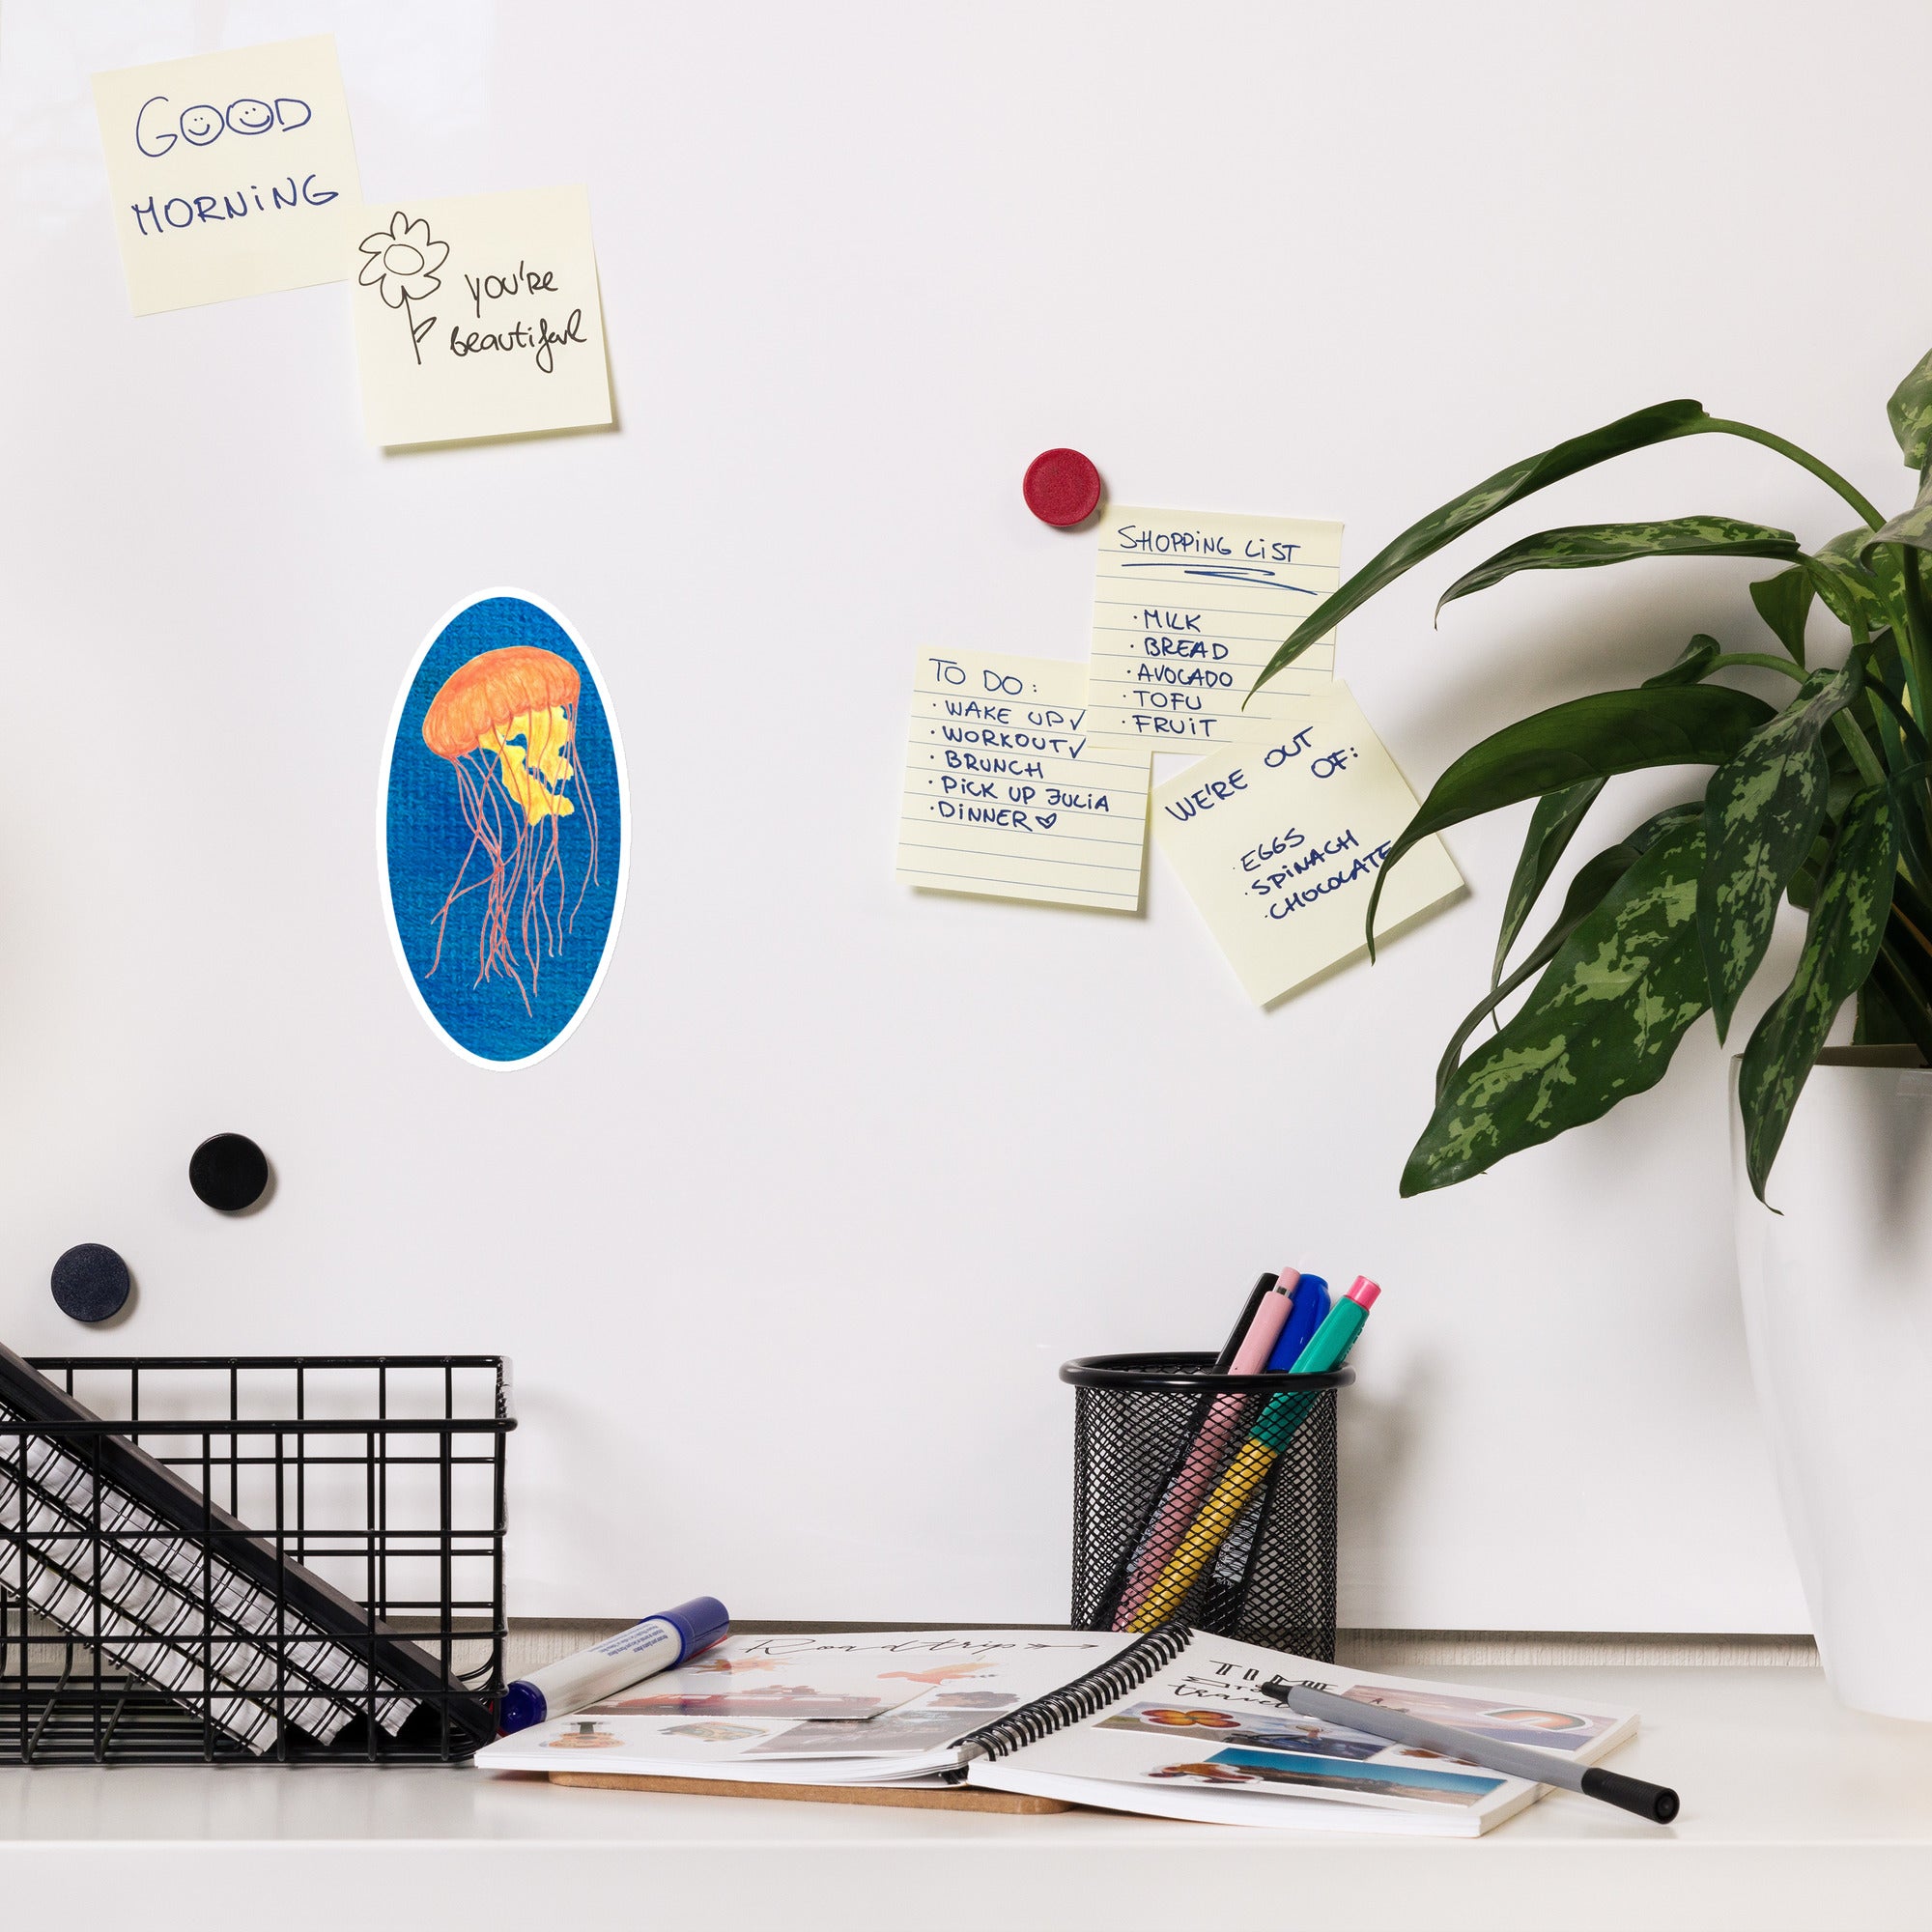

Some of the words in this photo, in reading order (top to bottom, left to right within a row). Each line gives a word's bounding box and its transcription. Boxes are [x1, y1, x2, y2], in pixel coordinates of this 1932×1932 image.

[135, 96, 312, 158] GOOD
[449, 308, 587, 374] beautiful
[1143, 609, 1202, 633] MILK
[1144, 637, 1229, 661] BREAD
[928, 658, 966, 685] TO
[1137, 663, 1234, 689] AVOCADO
[945, 699, 1012, 724] WAKE
[1027, 710, 1065, 727] UP
[1132, 690, 1203, 711] TOFU
[942, 725, 1068, 753] WORKOUT
[944, 750, 1044, 780] BRUNCH
[1164, 768, 1248, 822] WE'RE
[1264, 725, 1314, 768] OUT
[1310, 747, 1359, 779] OF:
[1008, 785, 1037, 806] UP
[1239, 827, 1305, 872] EGGS
